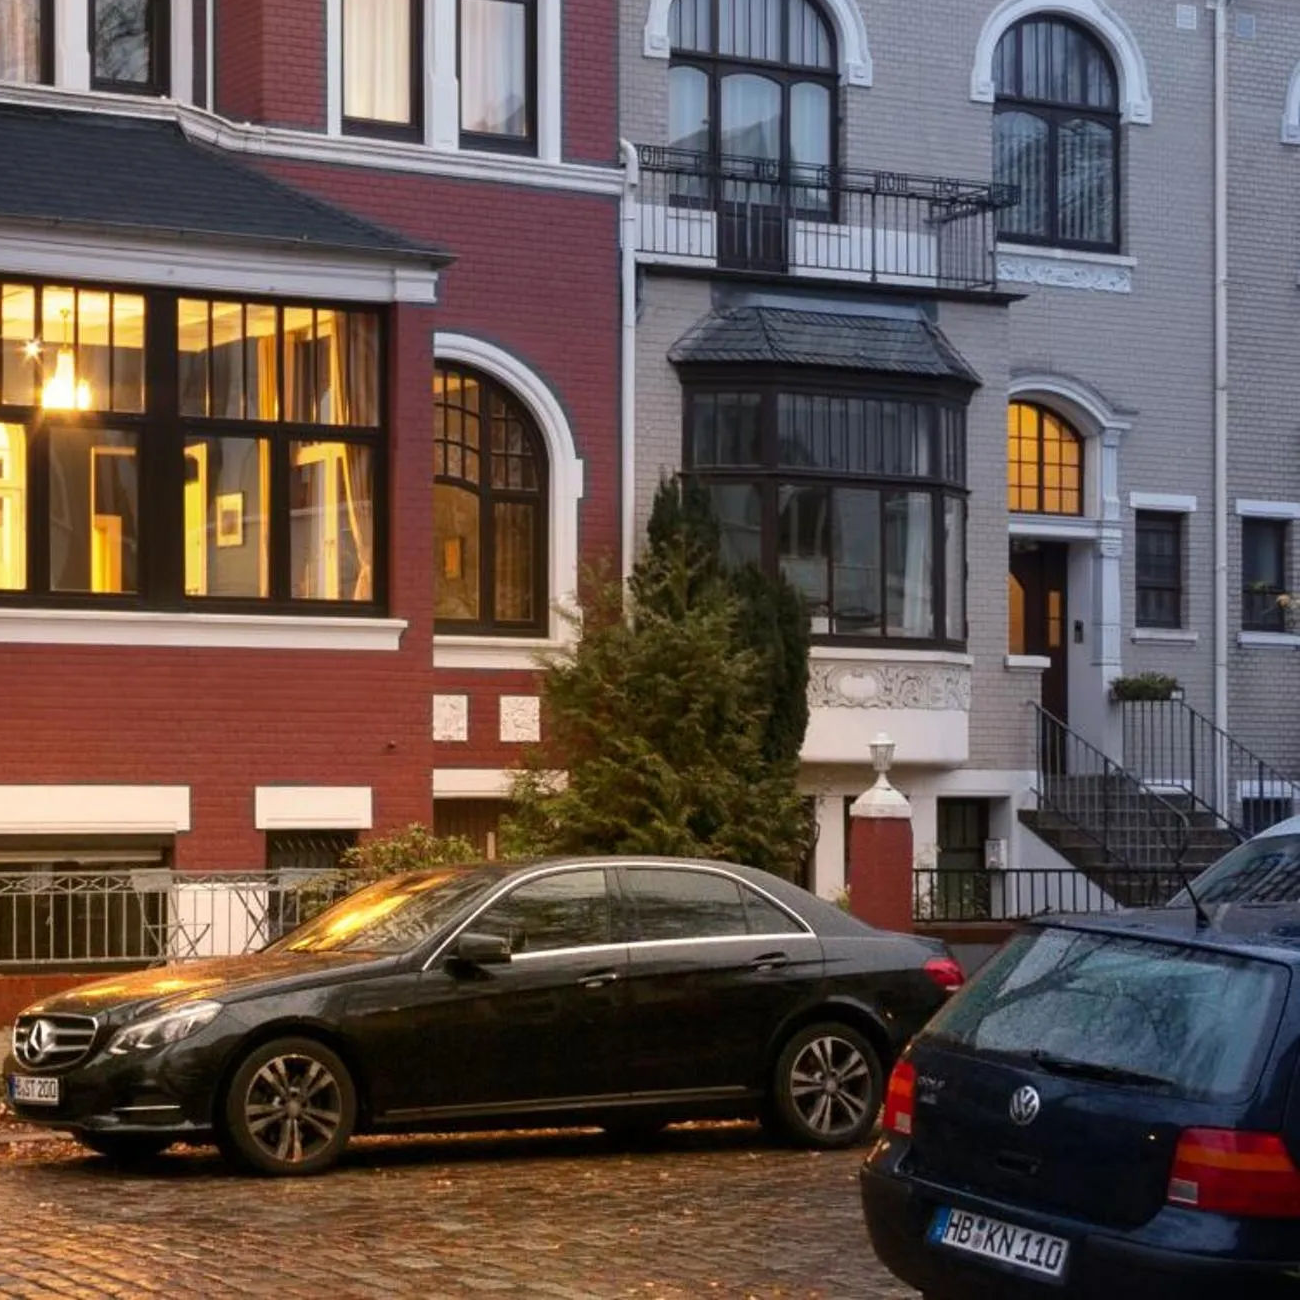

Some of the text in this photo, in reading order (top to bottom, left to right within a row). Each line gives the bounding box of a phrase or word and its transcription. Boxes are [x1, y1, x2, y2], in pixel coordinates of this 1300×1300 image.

[944, 1210, 1065, 1271] HB KN 110
